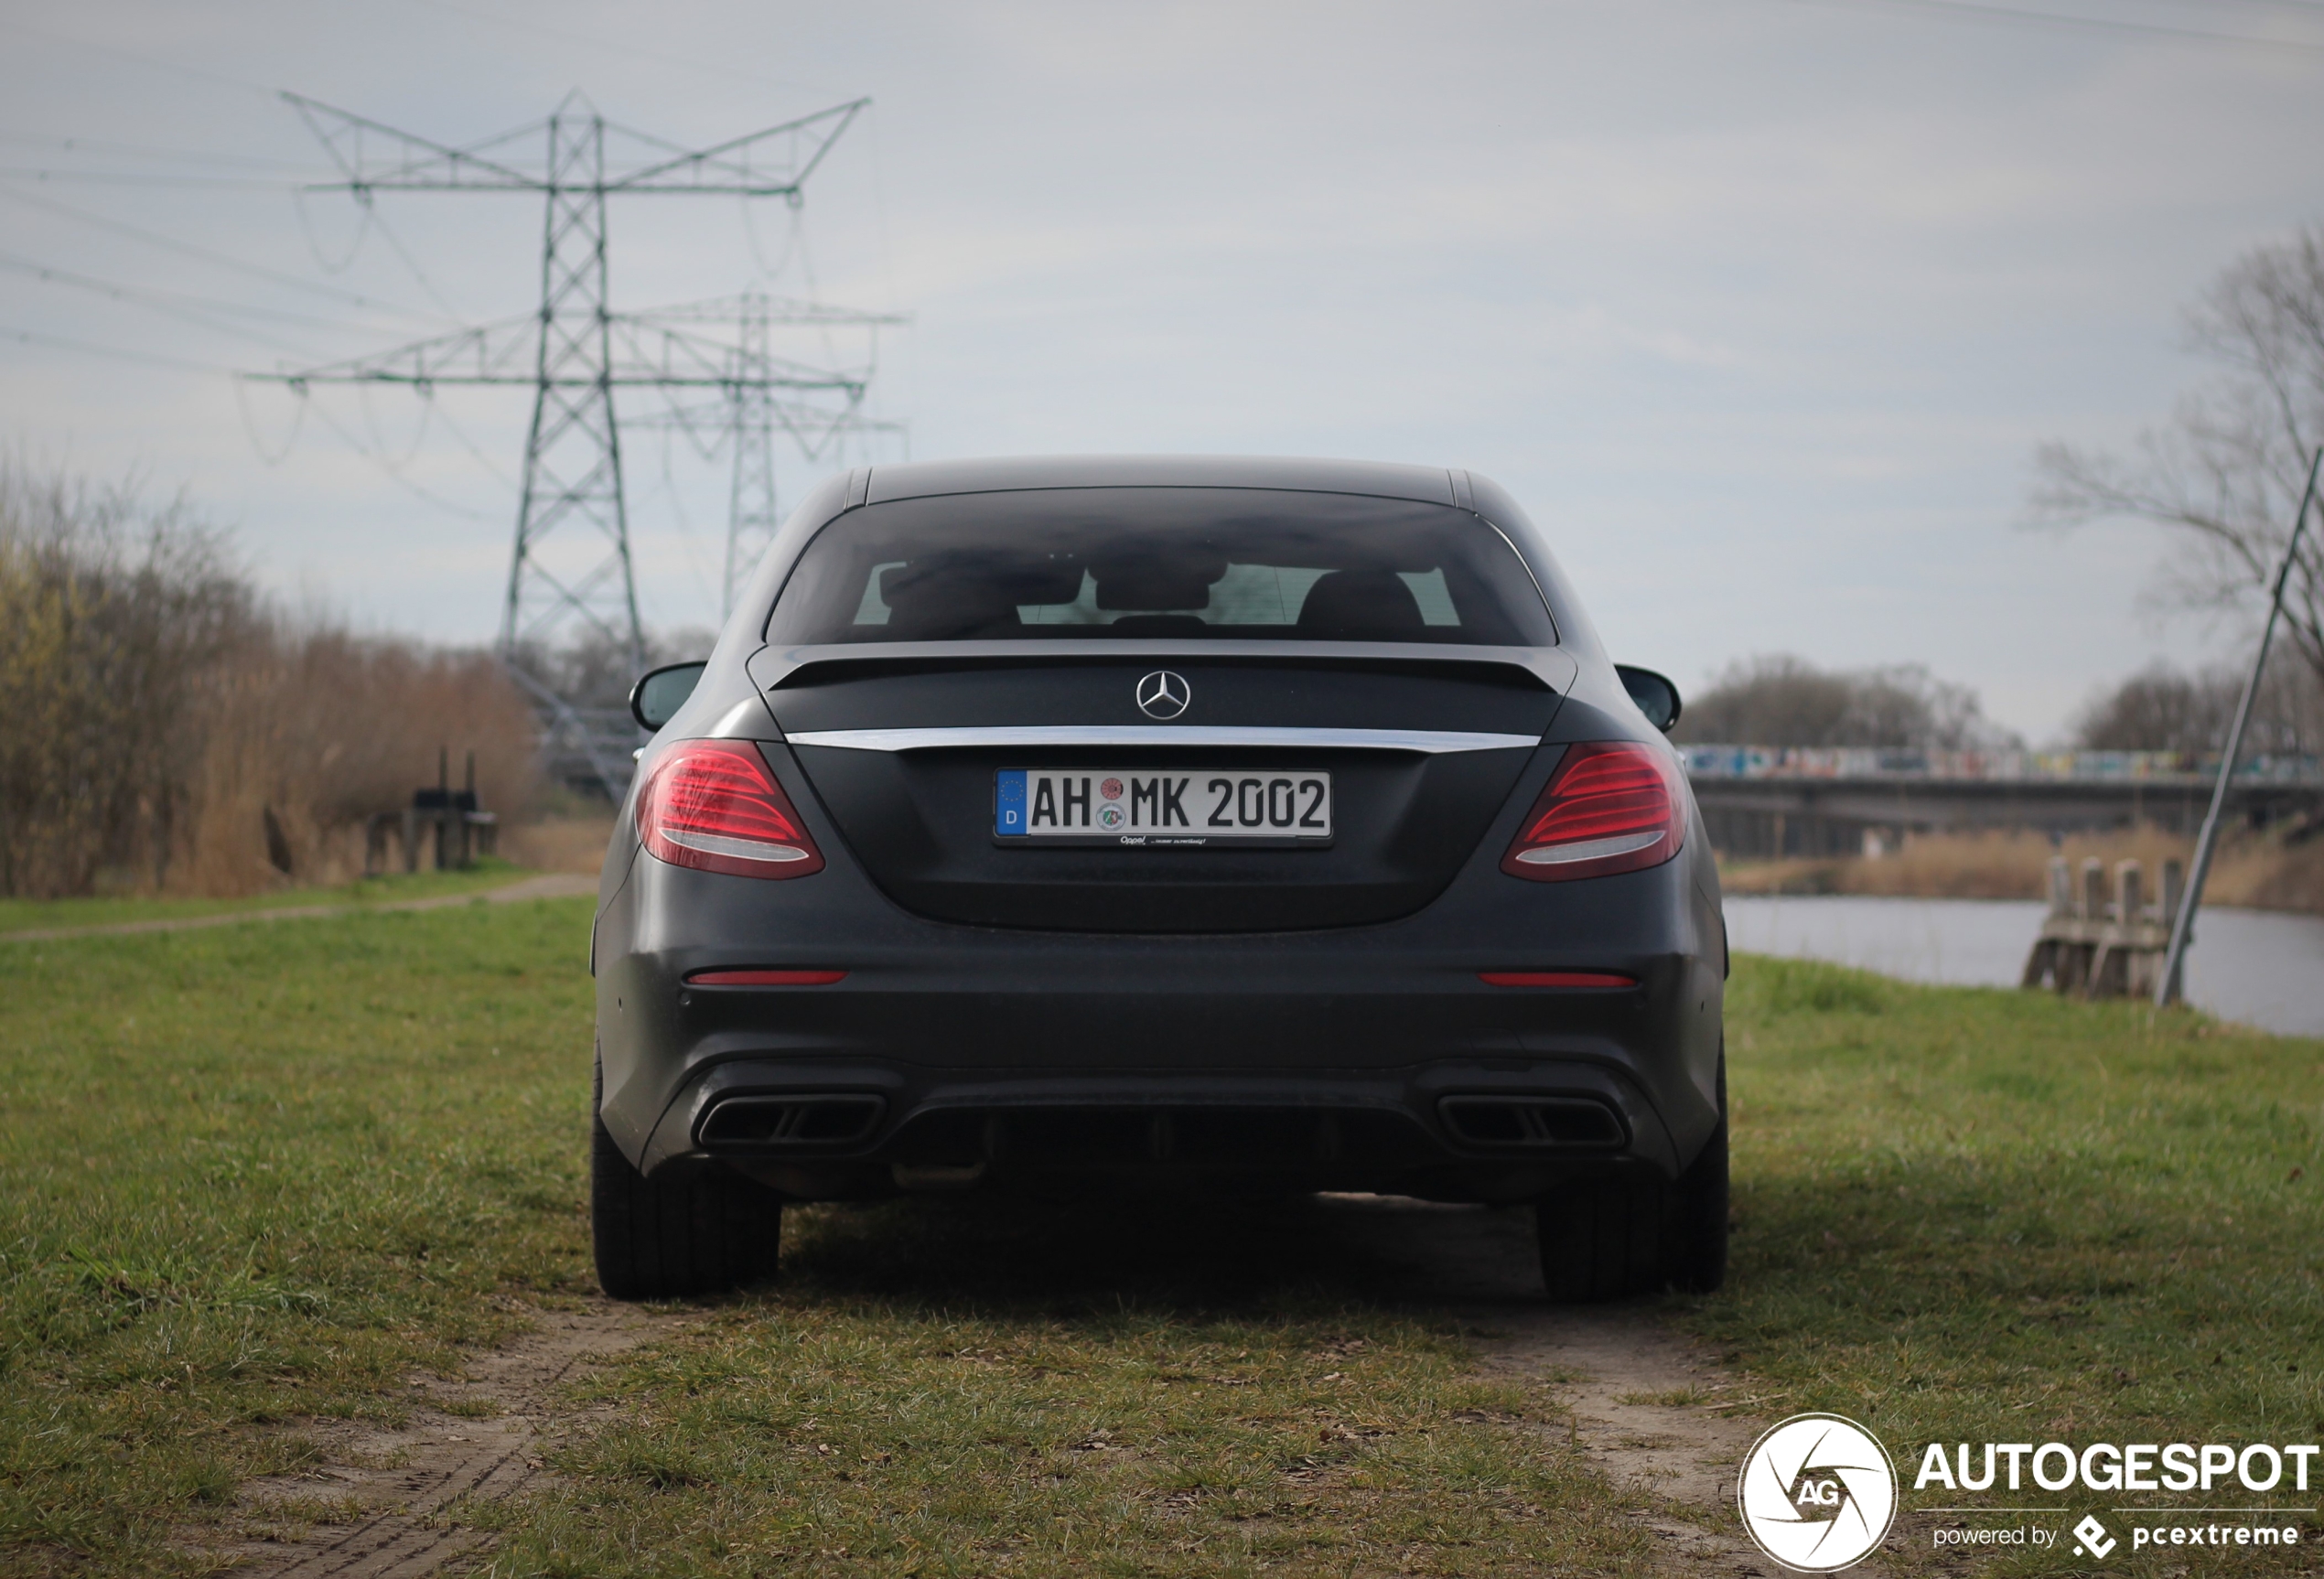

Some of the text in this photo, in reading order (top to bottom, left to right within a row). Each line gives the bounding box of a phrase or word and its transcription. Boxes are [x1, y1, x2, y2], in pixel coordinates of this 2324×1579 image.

[1006, 810, 1017, 824] D
[1031, 778, 1092, 827] AH
[1131, 778, 1190, 827] MK
[1208, 779, 1326, 828] 2002
